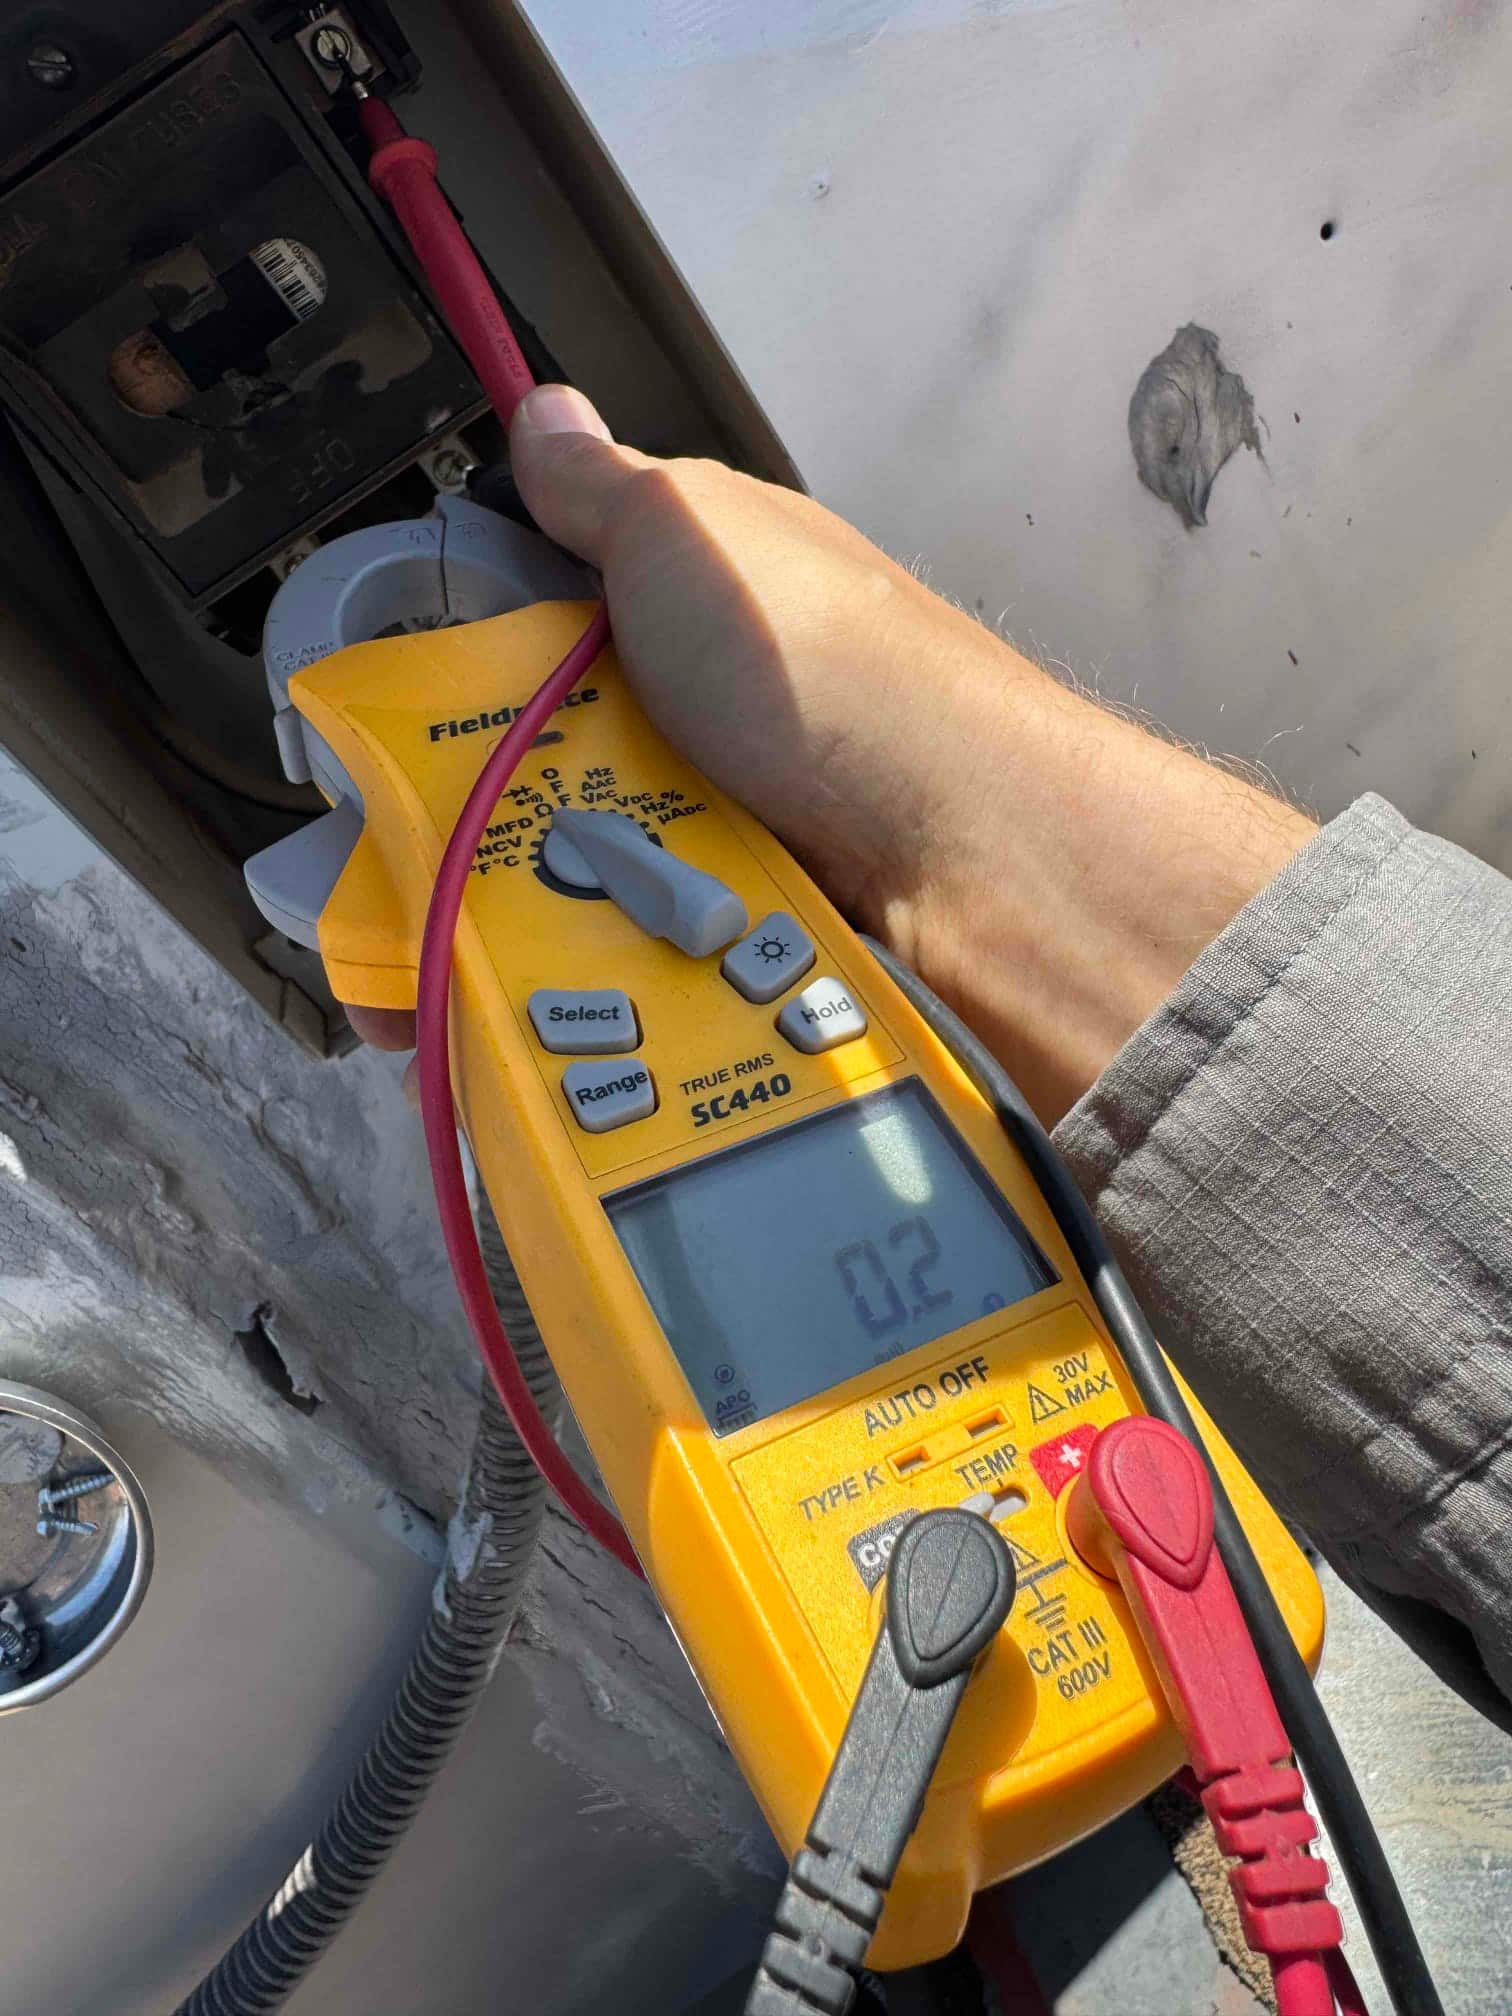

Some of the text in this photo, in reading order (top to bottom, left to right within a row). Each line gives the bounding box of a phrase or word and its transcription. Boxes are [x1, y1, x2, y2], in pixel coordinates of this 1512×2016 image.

[429, 688, 600, 742] Fieldce
[585, 767, 613, 780] Hz
[476, 835, 522, 858] NCV
[486, 817, 533, 838] MFD
[548, 1006, 620, 1022] Select
[801, 998, 852, 1025] Hold
[575, 1071, 648, 1105] Range
[680, 1053, 774, 1096] TRUE RMS
[690, 1073, 791, 1127] SC440
[1053, 1352, 1088, 1384] 30V
[1065, 1371, 1114, 1407] MAX
[863, 1357, 990, 1436] AUTO OFF
[955, 1443, 1019, 1490] TEMP
[799, 1465, 885, 1520] TYPE K
[857, 1524, 904, 1567] CO
[1027, 1615, 1106, 1675] CAT III
[1057, 1651, 1111, 1700] 600V
